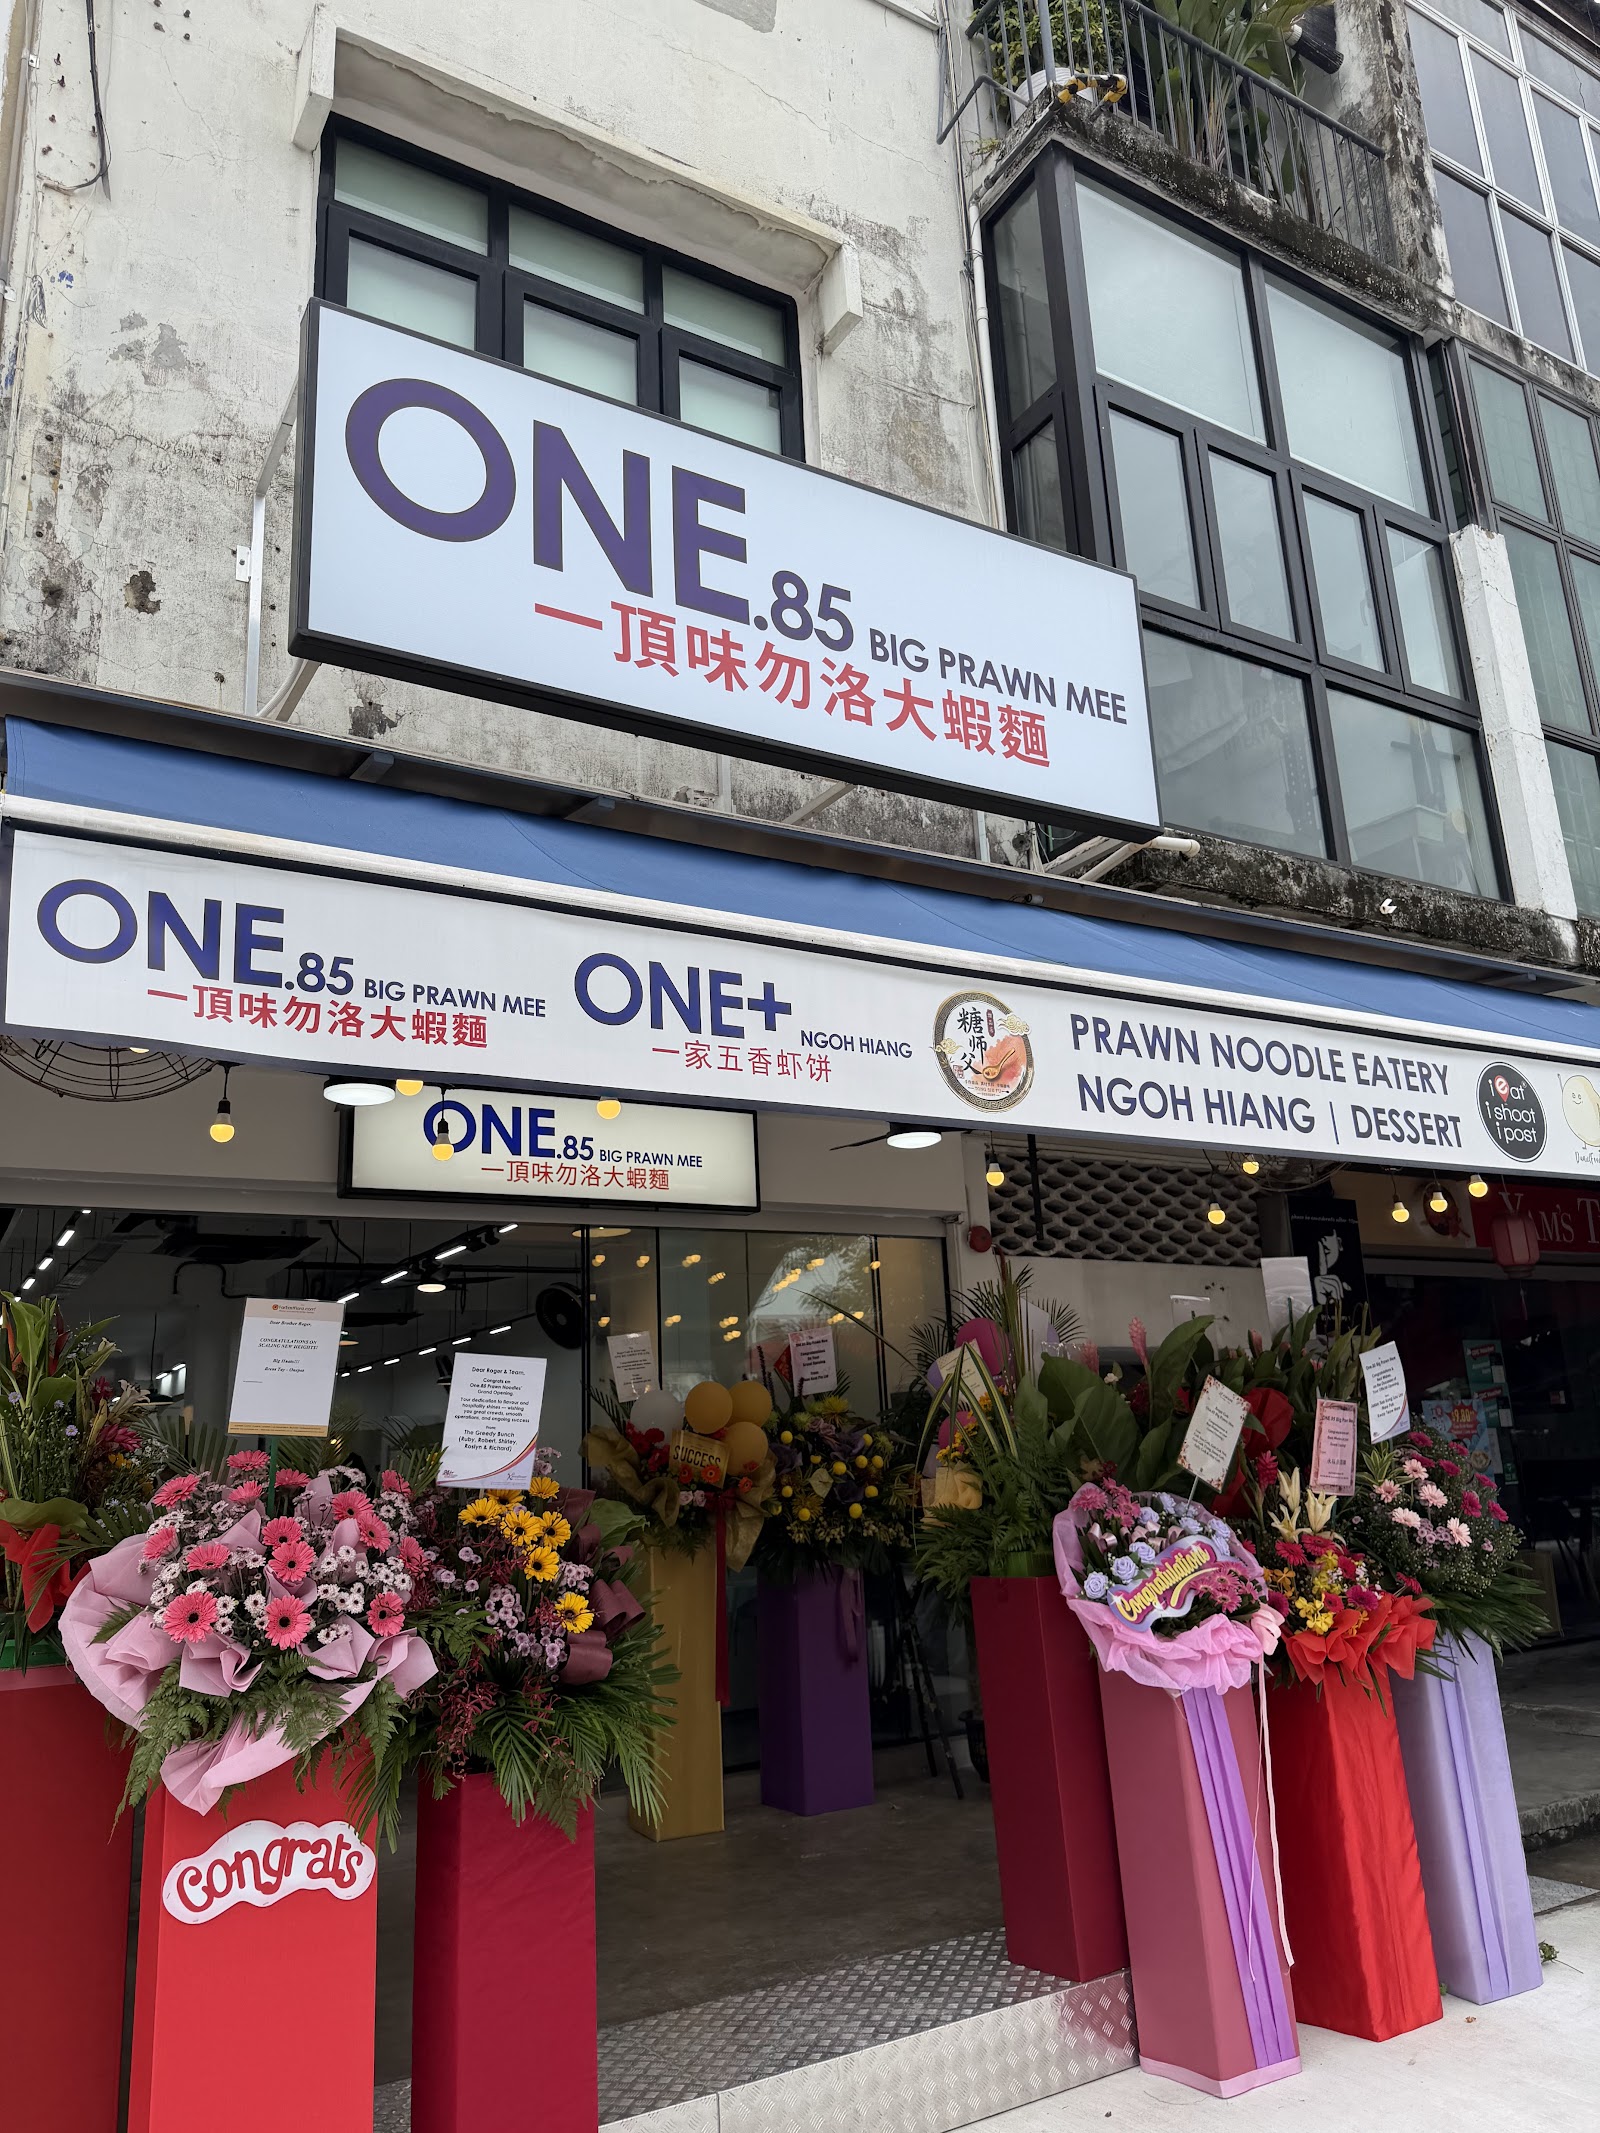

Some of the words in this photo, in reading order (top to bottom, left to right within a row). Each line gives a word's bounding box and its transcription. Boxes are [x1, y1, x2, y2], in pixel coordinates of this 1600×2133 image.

[345, 378, 853, 651] ONE.85
[872, 629, 928, 673] BIG
[940, 647, 1057, 710] PRAWN
[1066, 683, 1126, 725] MEE
[534, 602, 1050, 769] 一頂味勿洛大蝦麵
[36, 878, 354, 996] ONE.85
[364, 978, 405, 1002] BIG
[413, 984, 497, 1012] PRAWN
[502, 995, 547, 1019] MEE
[147, 984, 488, 1049] 一頂味勿洛大蝦麵
[574, 952, 792, 1039] ONE+
[800, 1030, 854, 1052] NGOH
[859, 1036, 913, 1060] HIANG
[651, 1040, 832, 1083] 一家五香虾饼
[1070, 1013, 1201, 1065] PRAWN
[1209, 1032, 1347, 1084] NOODLE
[1352, 1052, 1450, 1097] EATERY
[423, 1100, 595, 1161] ONE.85
[600, 1148, 623, 1163] BIG
[626, 1151, 675, 1166] PRAWN
[676, 1153, 703, 1169] MEE
[1077, 1074, 1194, 1123] NGOH
[1203, 1088, 1316, 1134] HIANG
[1350, 1104, 1463, 1148] DESSERT
[1494, 1103, 1536, 1123] shoot
[1503, 1126, 1537, 1144] post
[486, 1367, 503, 1375] Roger
[464, 1443, 483, 1451] Roslyn
[475, 1430, 497, 1438] Greedy
[673, 1445, 721, 1468] SUCCESS
[1115, 1543, 1211, 1622] Congratulations
